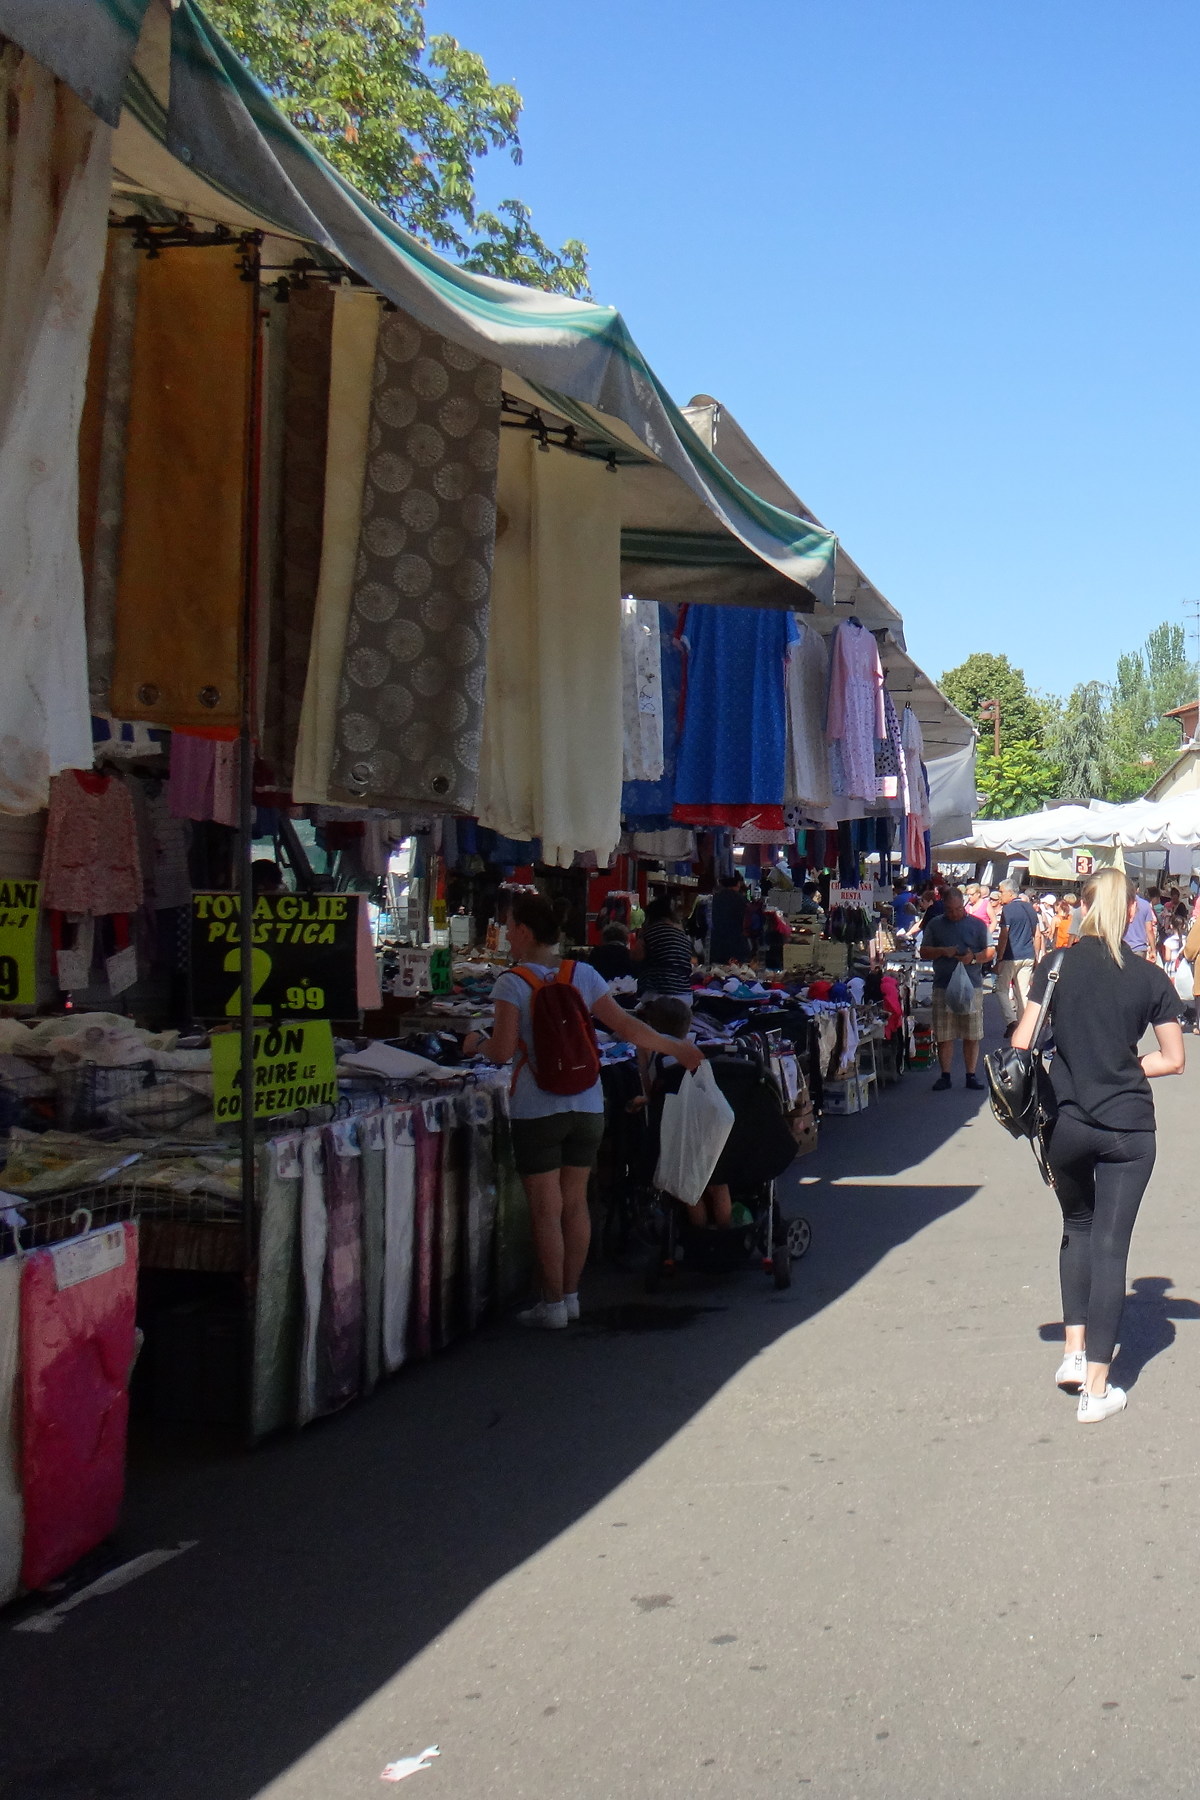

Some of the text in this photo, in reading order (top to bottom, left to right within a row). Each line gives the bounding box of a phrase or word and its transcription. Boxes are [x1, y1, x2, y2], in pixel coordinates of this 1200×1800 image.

[841, 891, 861, 900] RESTA
[208, 922, 336, 945] PLSTICA
[240, 1028, 304, 1060] ON
[231, 1061, 317, 1089] ARIRE LE
[217, 1081, 335, 1117] COFEZIONI!
